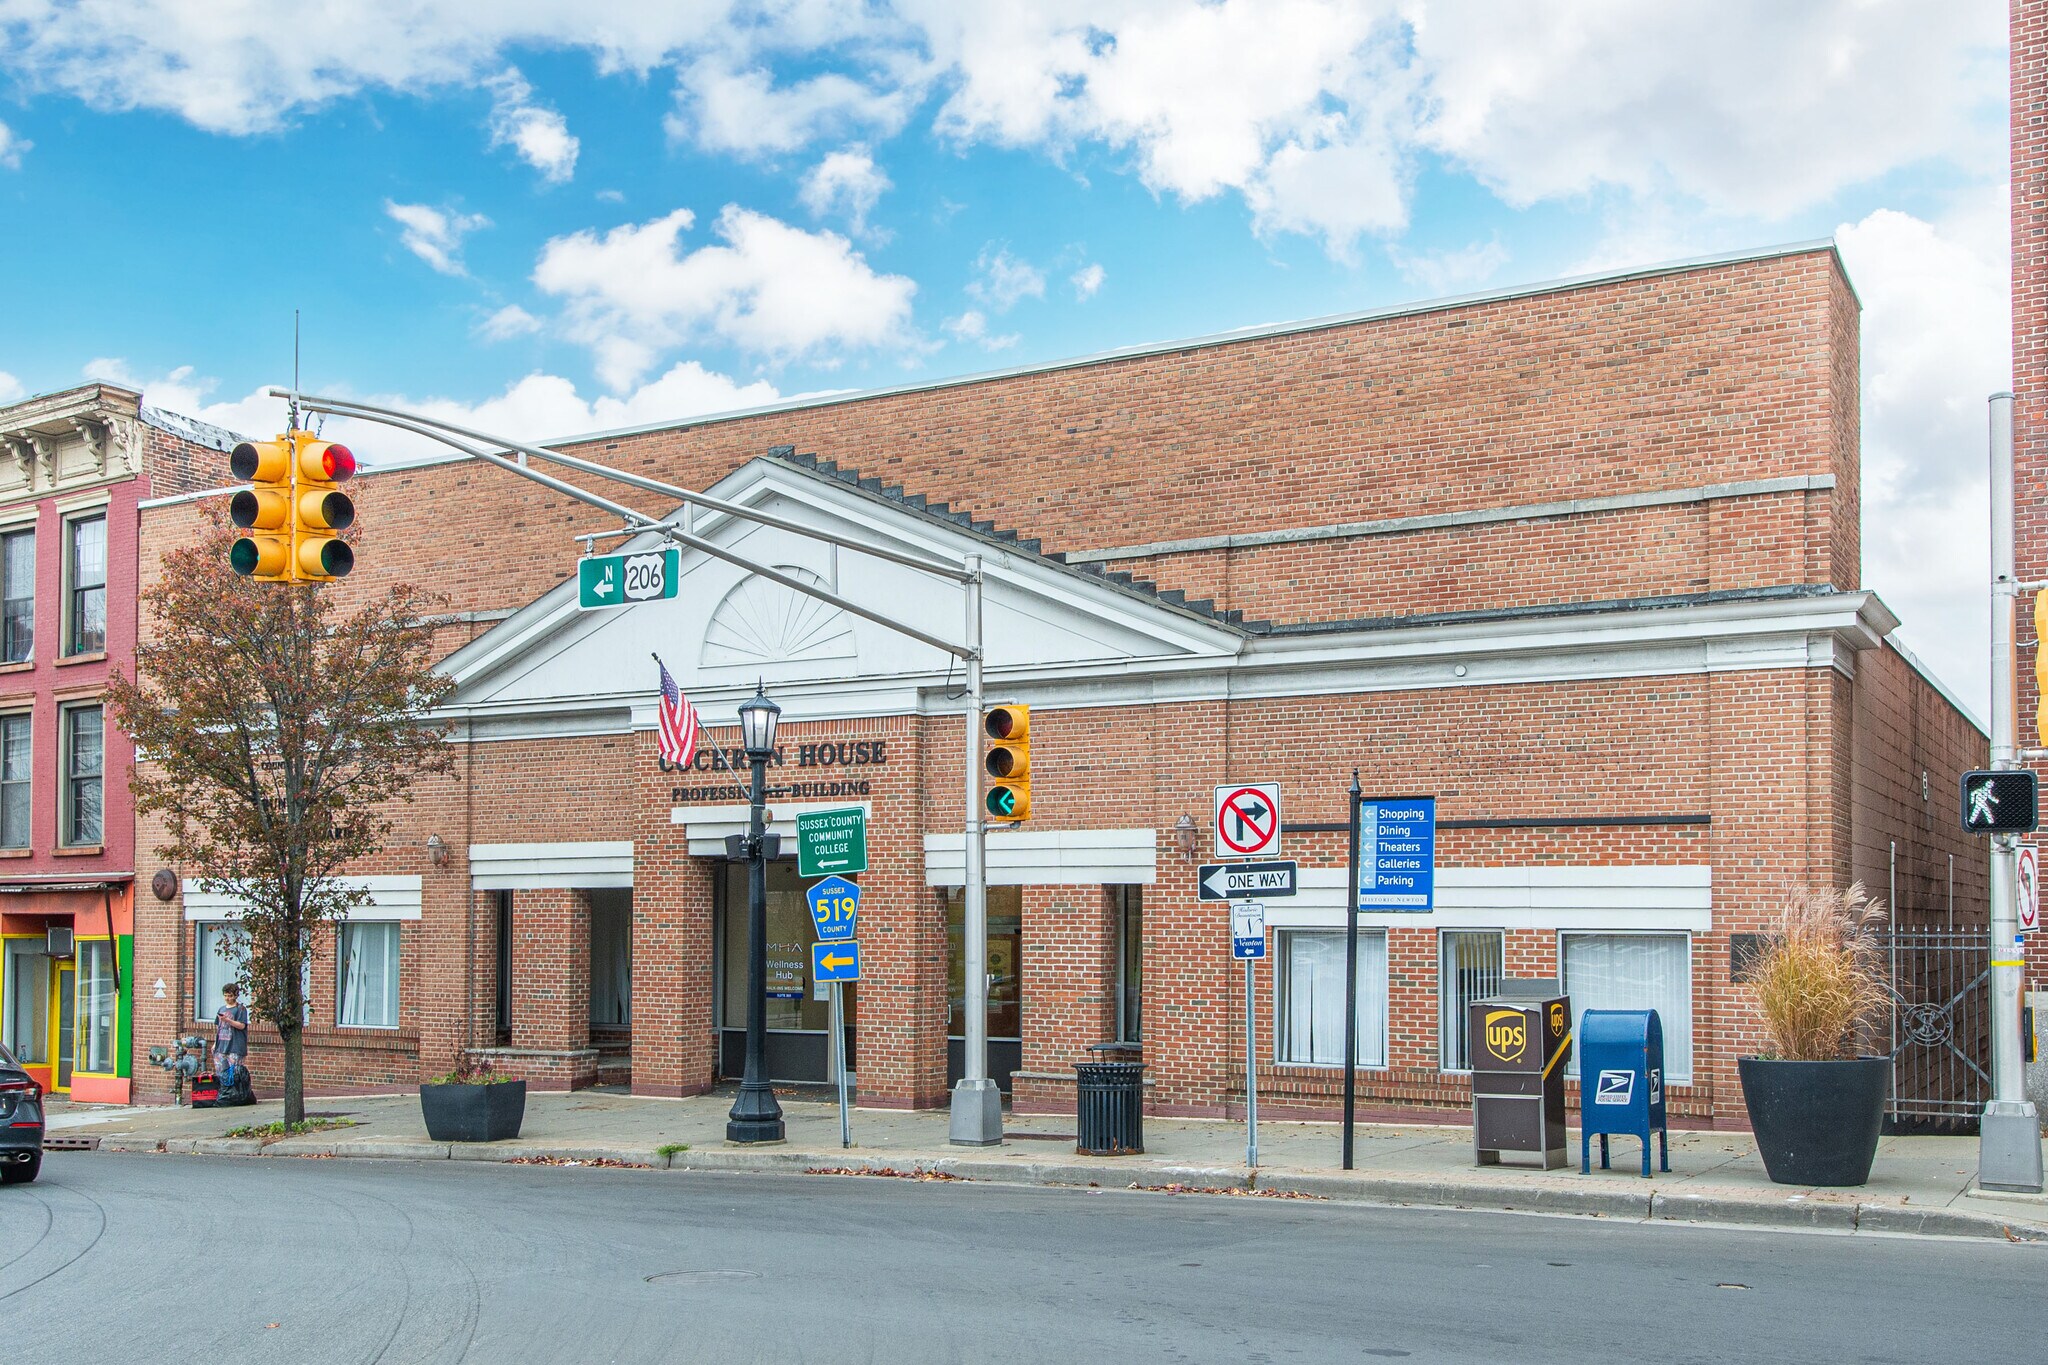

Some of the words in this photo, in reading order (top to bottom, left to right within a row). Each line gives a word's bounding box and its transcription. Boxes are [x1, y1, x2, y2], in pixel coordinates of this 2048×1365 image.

[605, 565, 613, 581] N
[628, 564, 660, 590] 206
[659, 746, 785, 773] CCHRN
[799, 741, 887, 767] HOUSE
[792, 781, 870, 798] BUILDING
[1379, 809, 1424, 820] Shopping
[800, 819, 829, 830] SUSSEX
[831, 815, 861, 827] COUNTY
[809, 829, 853, 843] COMMUNITY
[1379, 826, 1411, 837] Dining
[815, 843, 849, 855] COLLEGE
[1379, 842, 1420, 852] Theaters
[1378, 859, 1420, 869] Galleries
[1228, 874, 1254, 888] ONE
[1259, 873, 1286, 887] WAY
[1378, 876, 1414, 887] Parking
[822, 887, 846, 895] SUSSEX
[817, 897, 855, 922] 519
[822, 925, 847, 933] COUNTY
[766, 943, 803, 952] MHA
[1235, 938, 1263, 947] Newton
[766, 960, 804, 969] Wellness
[775, 971, 793, 979] Hub
[1552, 1013, 1563, 1031] ups
[1489, 1026, 1523, 1053] ups
